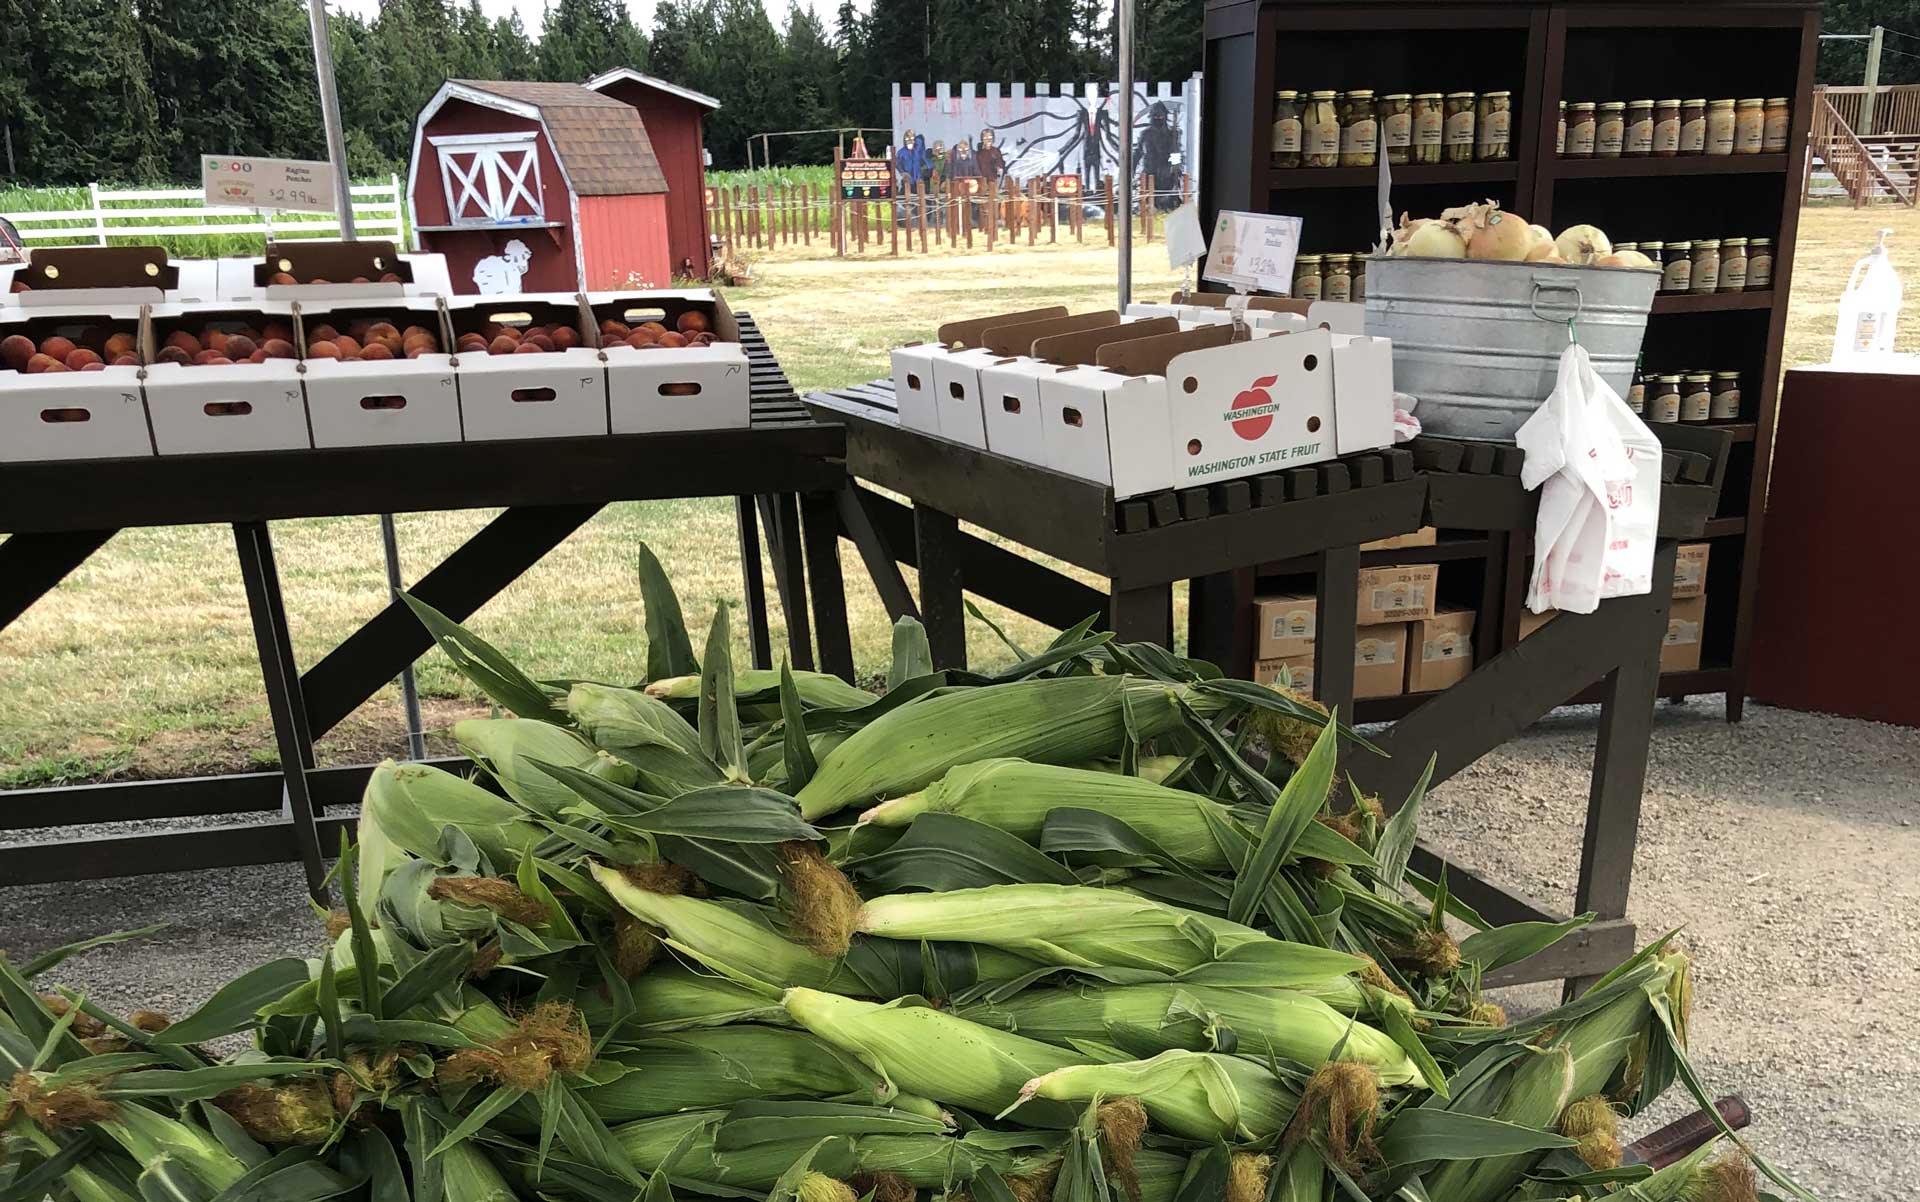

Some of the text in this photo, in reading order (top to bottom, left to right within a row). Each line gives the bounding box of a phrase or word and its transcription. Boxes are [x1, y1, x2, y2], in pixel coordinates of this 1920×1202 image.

[1223, 403, 1281, 421] WASHINGTON
[1188, 442, 1321, 477] WASHINGTON STATE FRUIT
